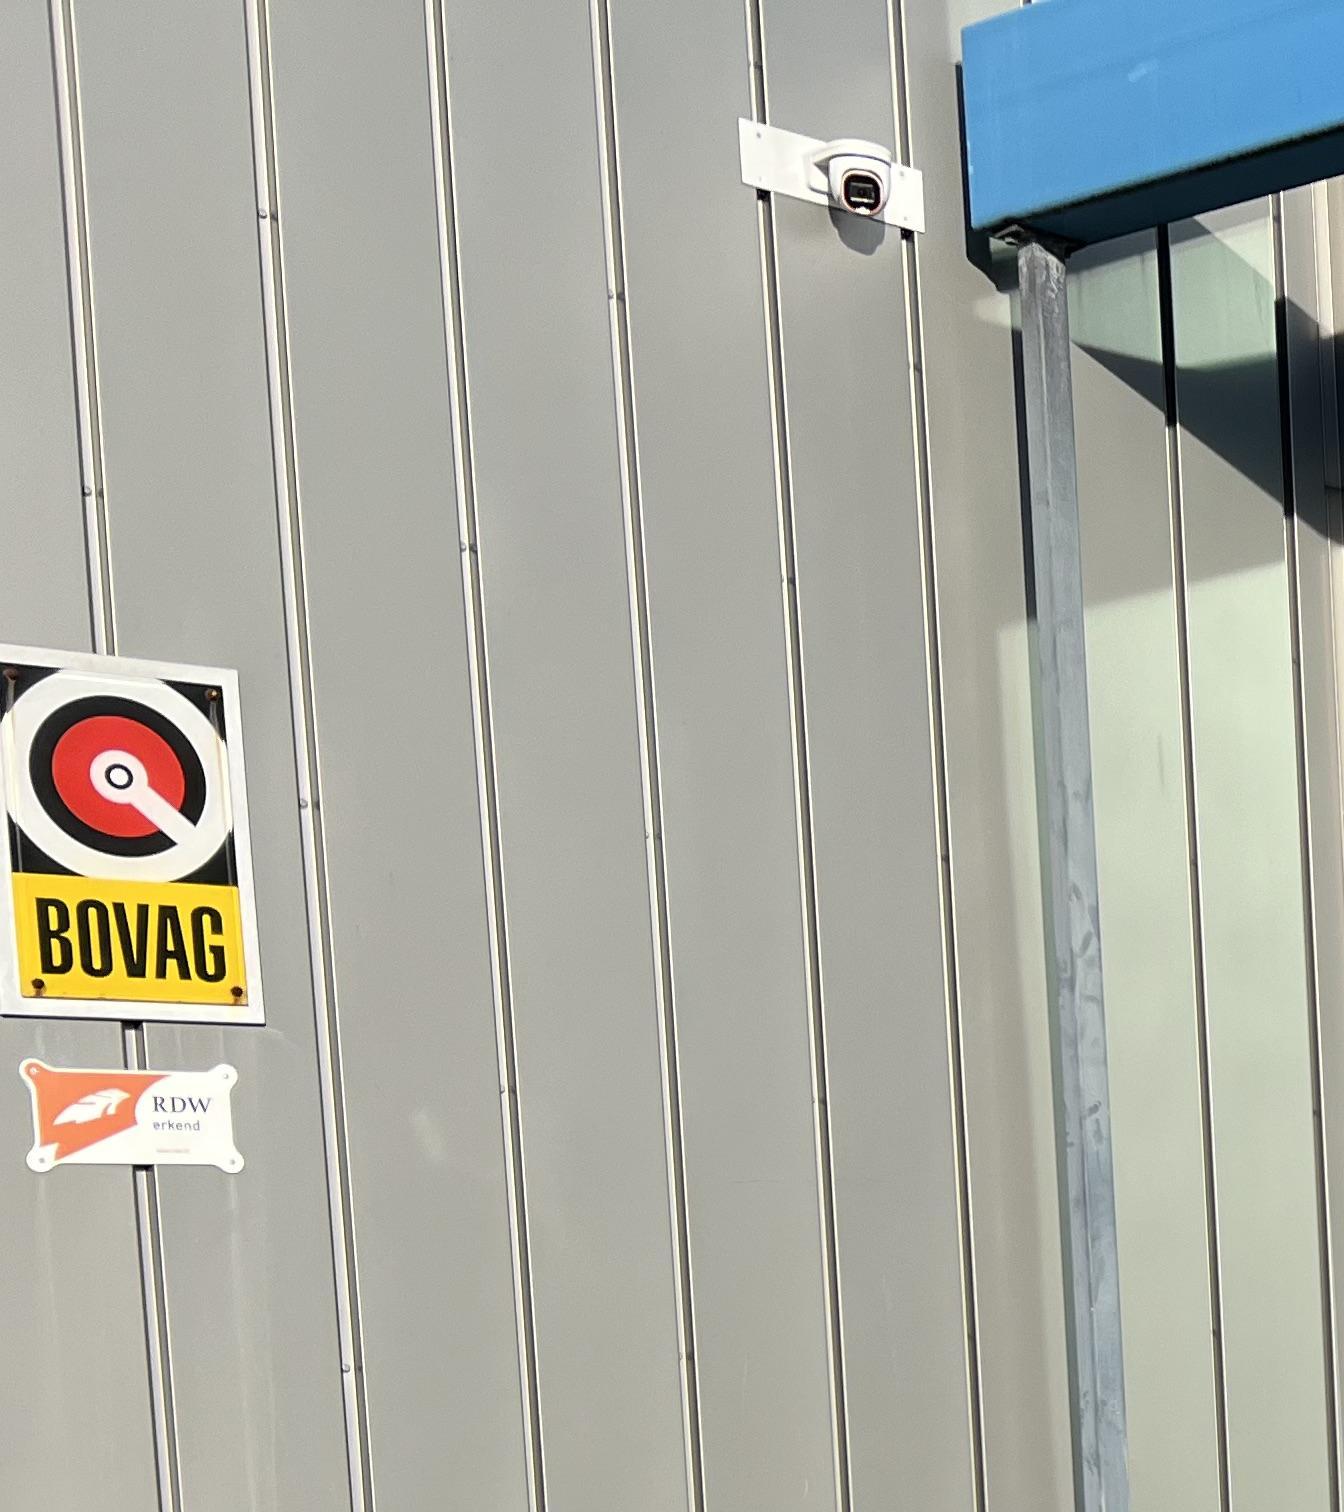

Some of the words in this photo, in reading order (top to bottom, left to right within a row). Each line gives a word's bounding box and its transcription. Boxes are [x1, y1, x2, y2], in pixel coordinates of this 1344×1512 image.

[35, 897, 227, 983] BOVAG
[153, 1096, 212, 1114] RDW
[153, 1119, 201, 1132] erkend
